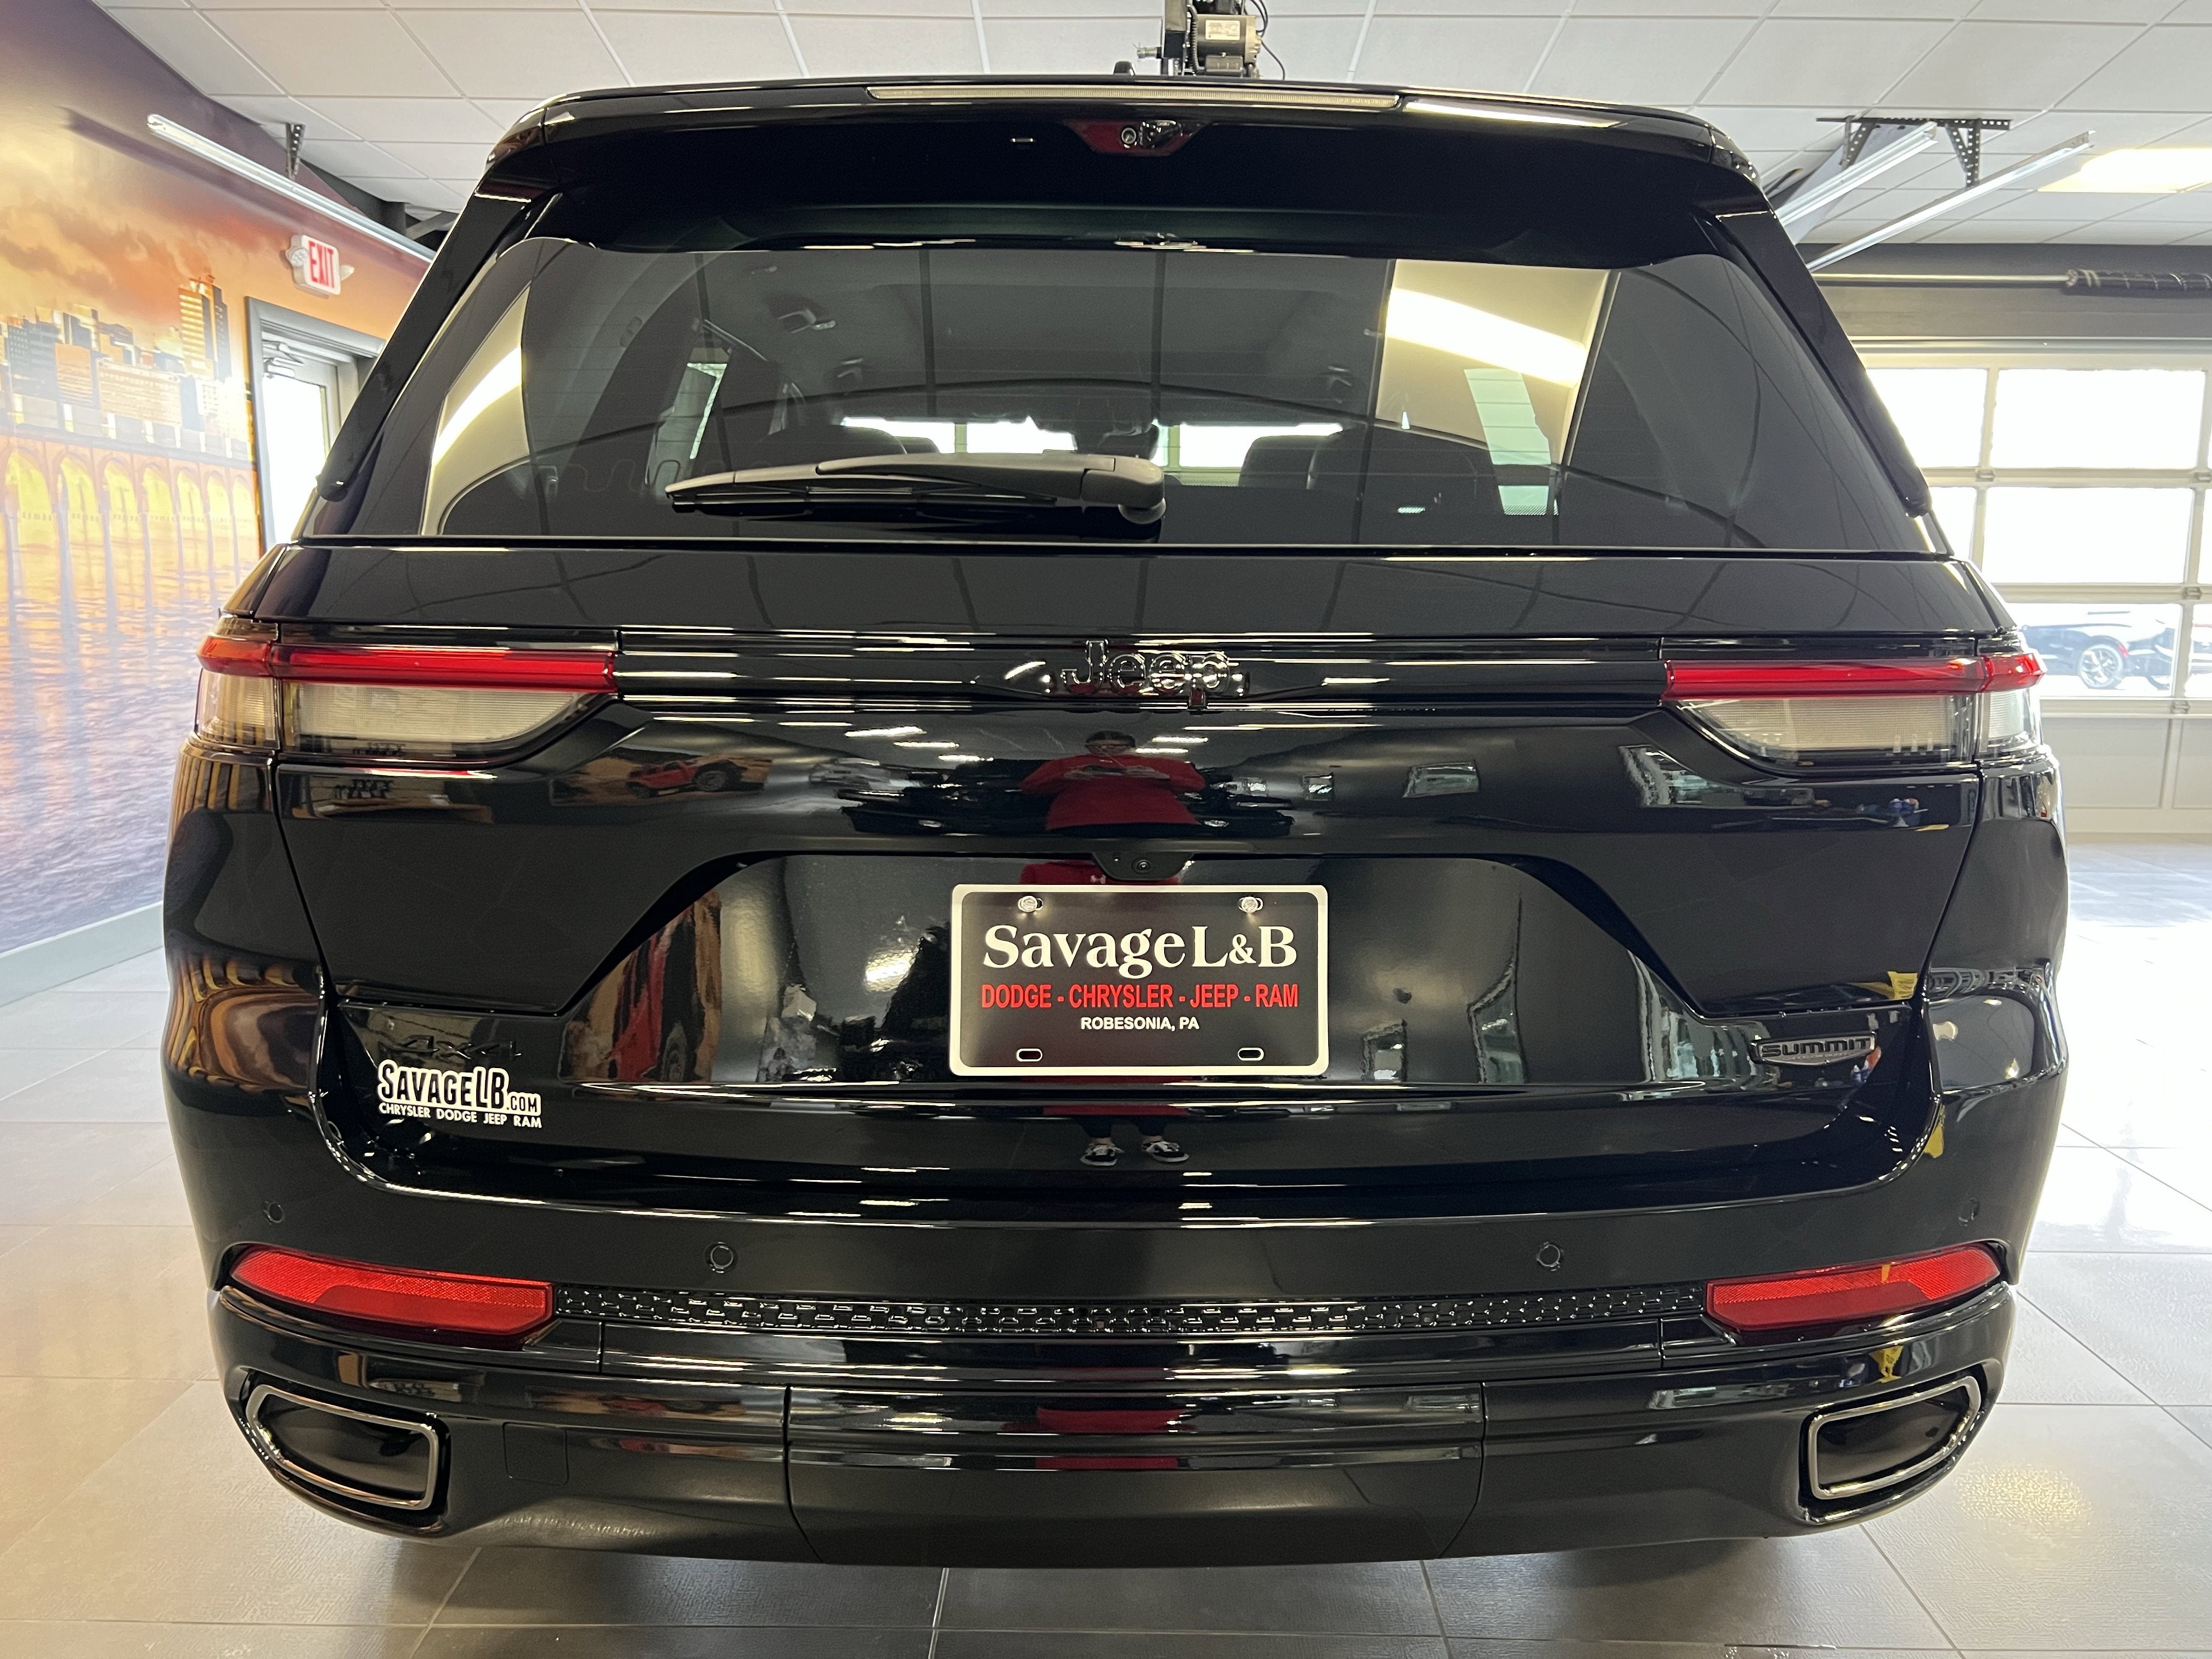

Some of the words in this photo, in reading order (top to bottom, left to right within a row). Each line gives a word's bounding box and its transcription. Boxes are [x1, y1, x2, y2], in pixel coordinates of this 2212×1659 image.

[309, 240, 334, 288] EXIT
[1060, 639, 1230, 708] Jeep
[984, 924, 1186, 979] Savage
[1192, 925, 1297, 968] L&B
[981, 984, 1052, 1008] DODGE
[1069, 984, 1174, 1008] CHRYSLER
[1190, 984, 1239, 1007] JEEP
[1256, 984, 1298, 1007] RAM
[1081, 1017, 1176, 1031] ROBESONIA,
[1179, 1017, 1200, 1030] PA
[1761, 1037, 1871, 1058] SUMMIT
[379, 1103, 431, 1119] CHRYSLER
[436, 1109, 477, 1123] DODGE
[483, 1113, 507, 1125] JEEP
[514, 1115, 542, 1128] RAM
